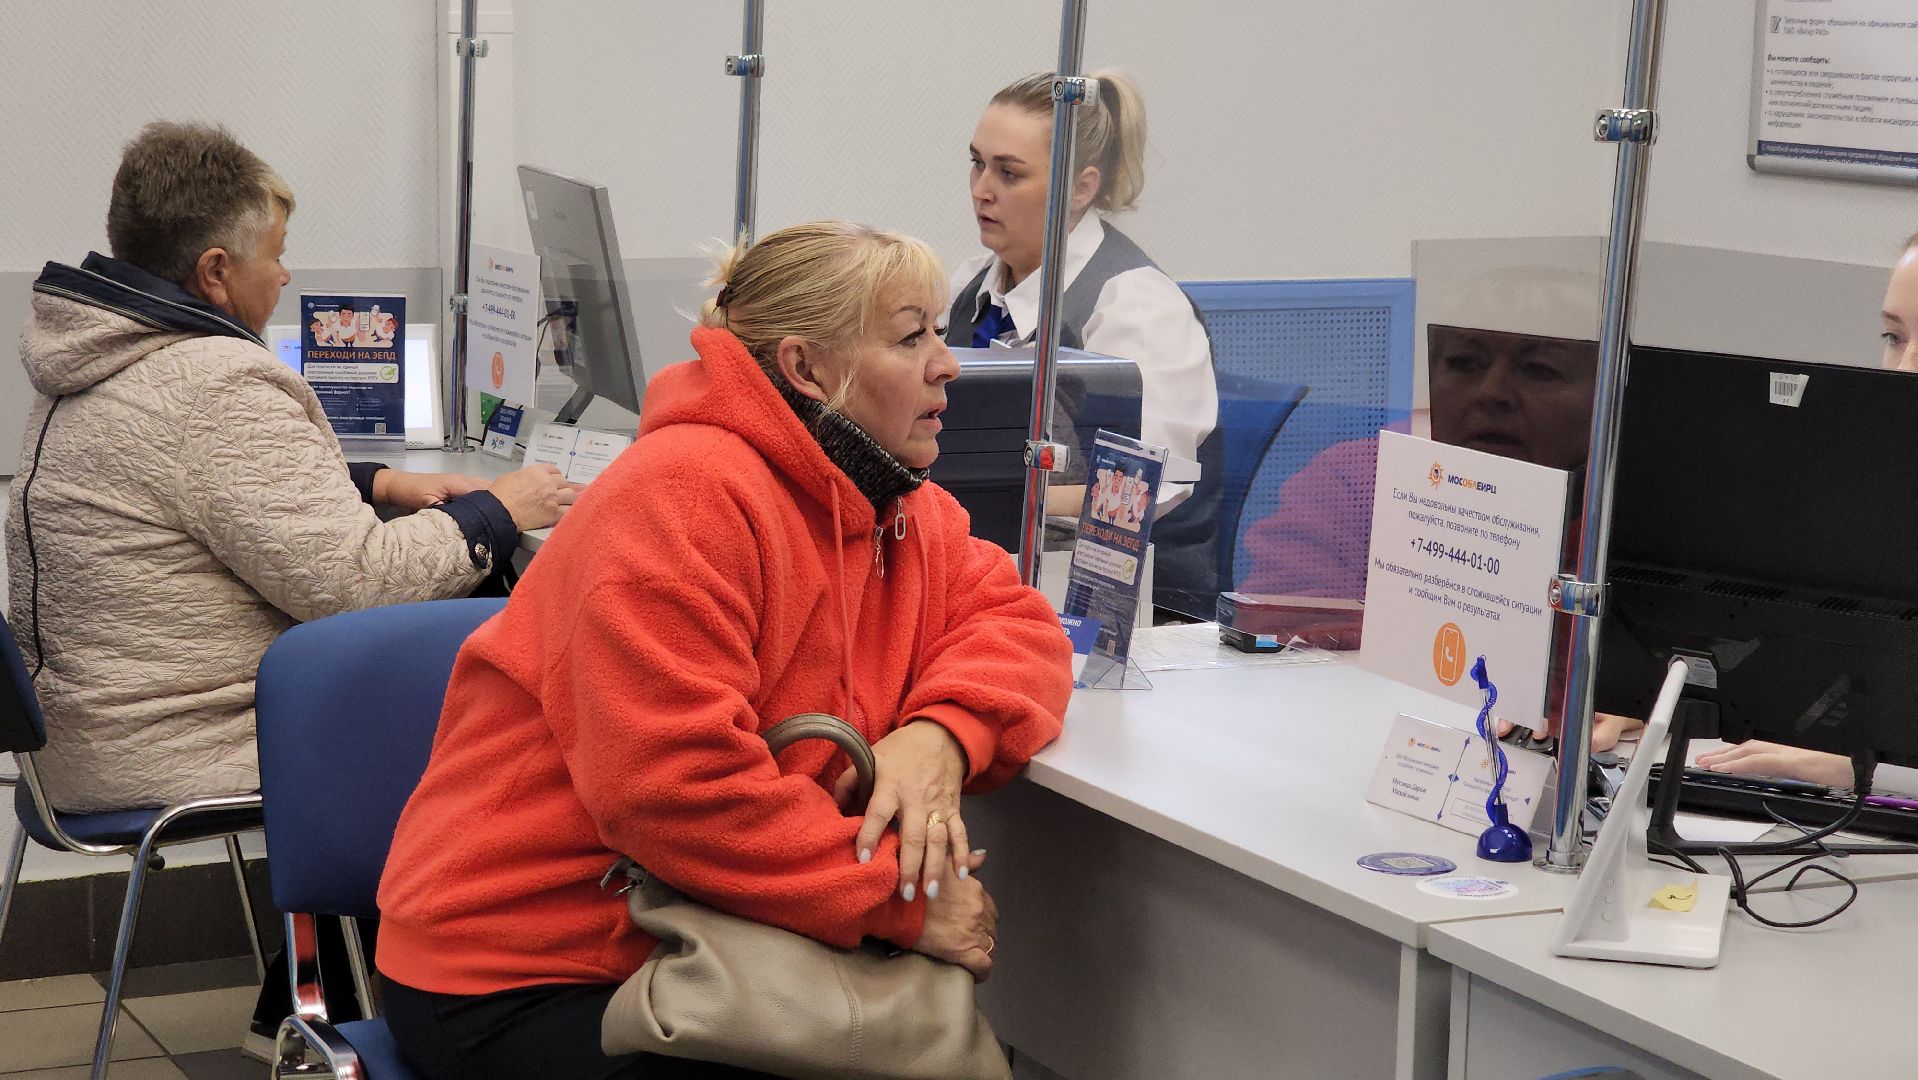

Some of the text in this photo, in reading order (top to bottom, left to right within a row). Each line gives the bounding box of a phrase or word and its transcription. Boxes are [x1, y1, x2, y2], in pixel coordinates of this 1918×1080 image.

[307, 350, 396, 361] ПЕРЕХОДИ НА ЭЕПД
[1448, 474, 1497, 494] МОСОБЛЕИРЦ
[1393, 487, 1541, 539] Если Вы недовольны качеством обслуживания,
[1408, 510, 1521, 551] пожалуйста, позвоните по телефону
[1410, 537, 1500, 576] +7-499-444-01-00
[1375, 557, 1543, 617] Мы обязательно разберёмся в сложившейся ситуации
[1408, 586, 1501, 622] и сообщим Вам о результатах
